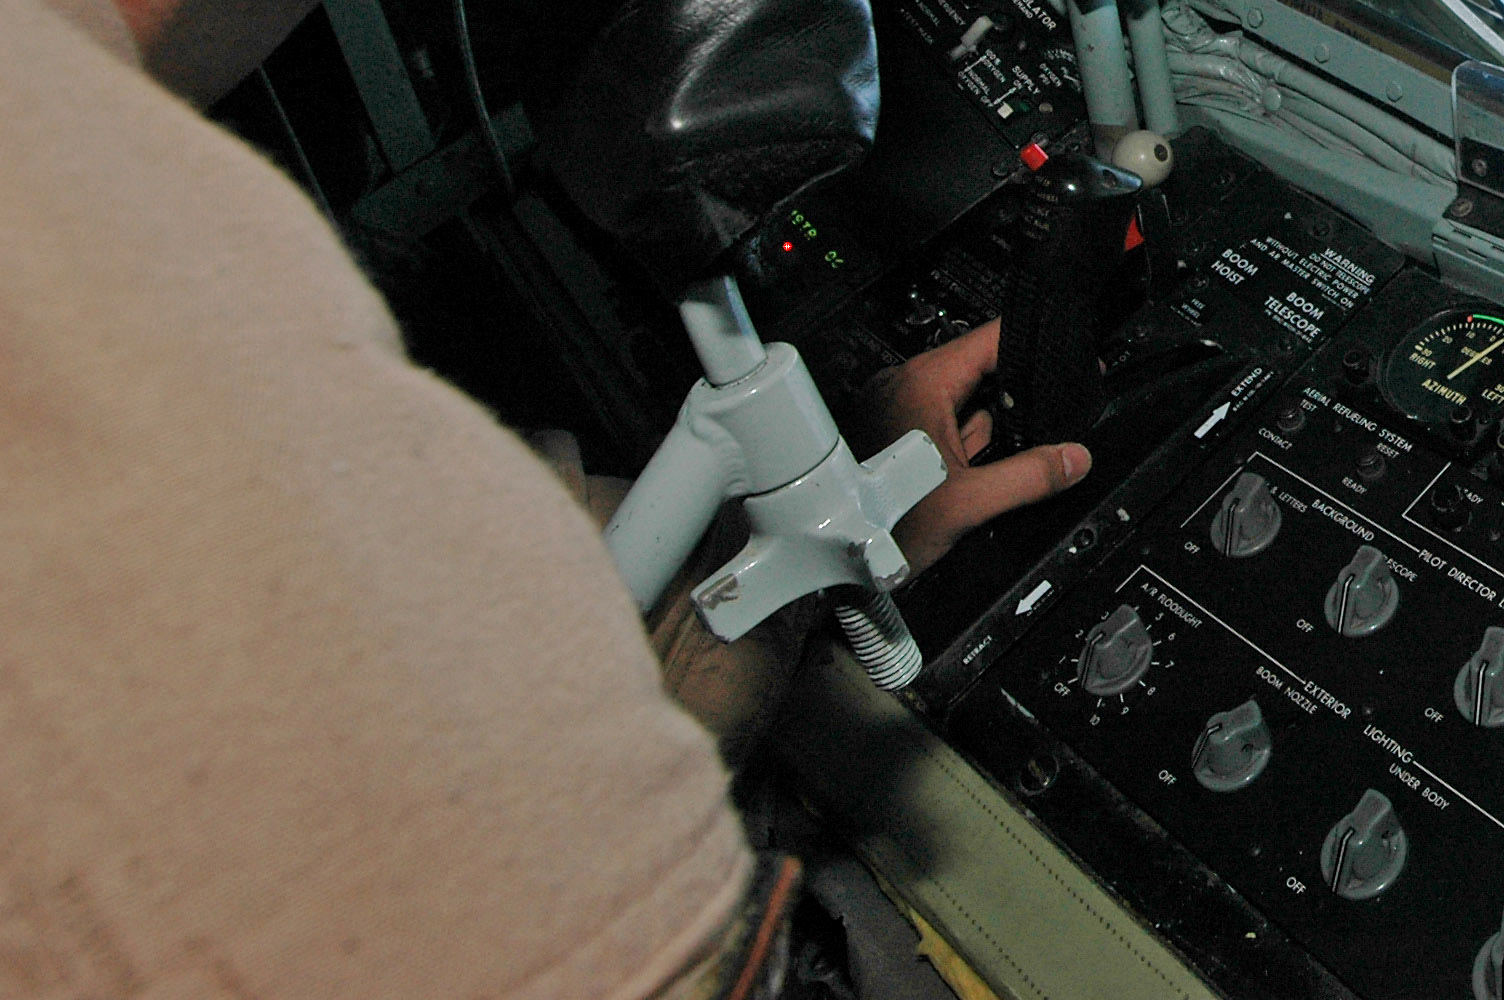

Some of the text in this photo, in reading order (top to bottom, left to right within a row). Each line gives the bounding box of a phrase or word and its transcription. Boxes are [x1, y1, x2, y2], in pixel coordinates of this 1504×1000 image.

[1012, 65, 1041, 95] SUPPLY
[1211, 260, 1245, 285] HOIST
[1222, 249, 1259, 277] BOOM
[1250, 238, 1268, 252] AND
[1281, 258, 1311, 280] MASTER
[1311, 278, 1338, 299] SWITCH
[1340, 297, 1354, 309] ON
[1266, 236, 1359, 299] WITHOUT ELECTRIC POWER
[1320, 259, 1336, 273] NOT
[1335, 268, 1371, 295] TELESCOPE
[1324, 248, 1376, 284] WARNING
[1264, 295, 1321, 338] TELESCOPE
[1286, 292, 1325, 321] BOOM
[1442, 335, 1453, 344] 20
[1466, 331, 1476, 339] 10
[1409, 352, 1436, 370] RIGHT
[1231, 367, 1262, 397] EXTEND
[1421, 378, 1467, 406] AZIMUTH
[1302, 387, 1330, 407] AERIAL
[1332, 402, 1377, 432] REFUELING
[1379, 427, 1414, 452] SYSTEM
[1258, 427, 1293, 450] CONTACT
[1376, 442, 1400, 459] RESET
[1341, 476, 1367, 495] READY
[1278, 491, 1308, 513] LETTERS
[1311, 499, 1375, 542] BACKGROUND
[1184, 540, 1200, 554] OFF
[1418, 549, 1447, 571] PILOT
[1447, 566, 1497, 601] DIRECTOR
[1141, 582, 1203, 629] A/R FLOODLIGHT
[1168, 632, 1176, 641] 6
[1296, 617, 1314, 634] OFF
[1054, 682, 1071, 697] OFF
[1147, 686, 1156, 696] 8
[1255, 665, 1318, 716] BOOM NOZZLE
[1304, 680, 1413, 764] EXTERIOR LIGHTING
[1424, 706, 1444, 724] OFF
[1158, 768, 1178, 786] OFF
[1389, 763, 1450, 811] UNDER BODY
[1285, 875, 1307, 896] OFF
